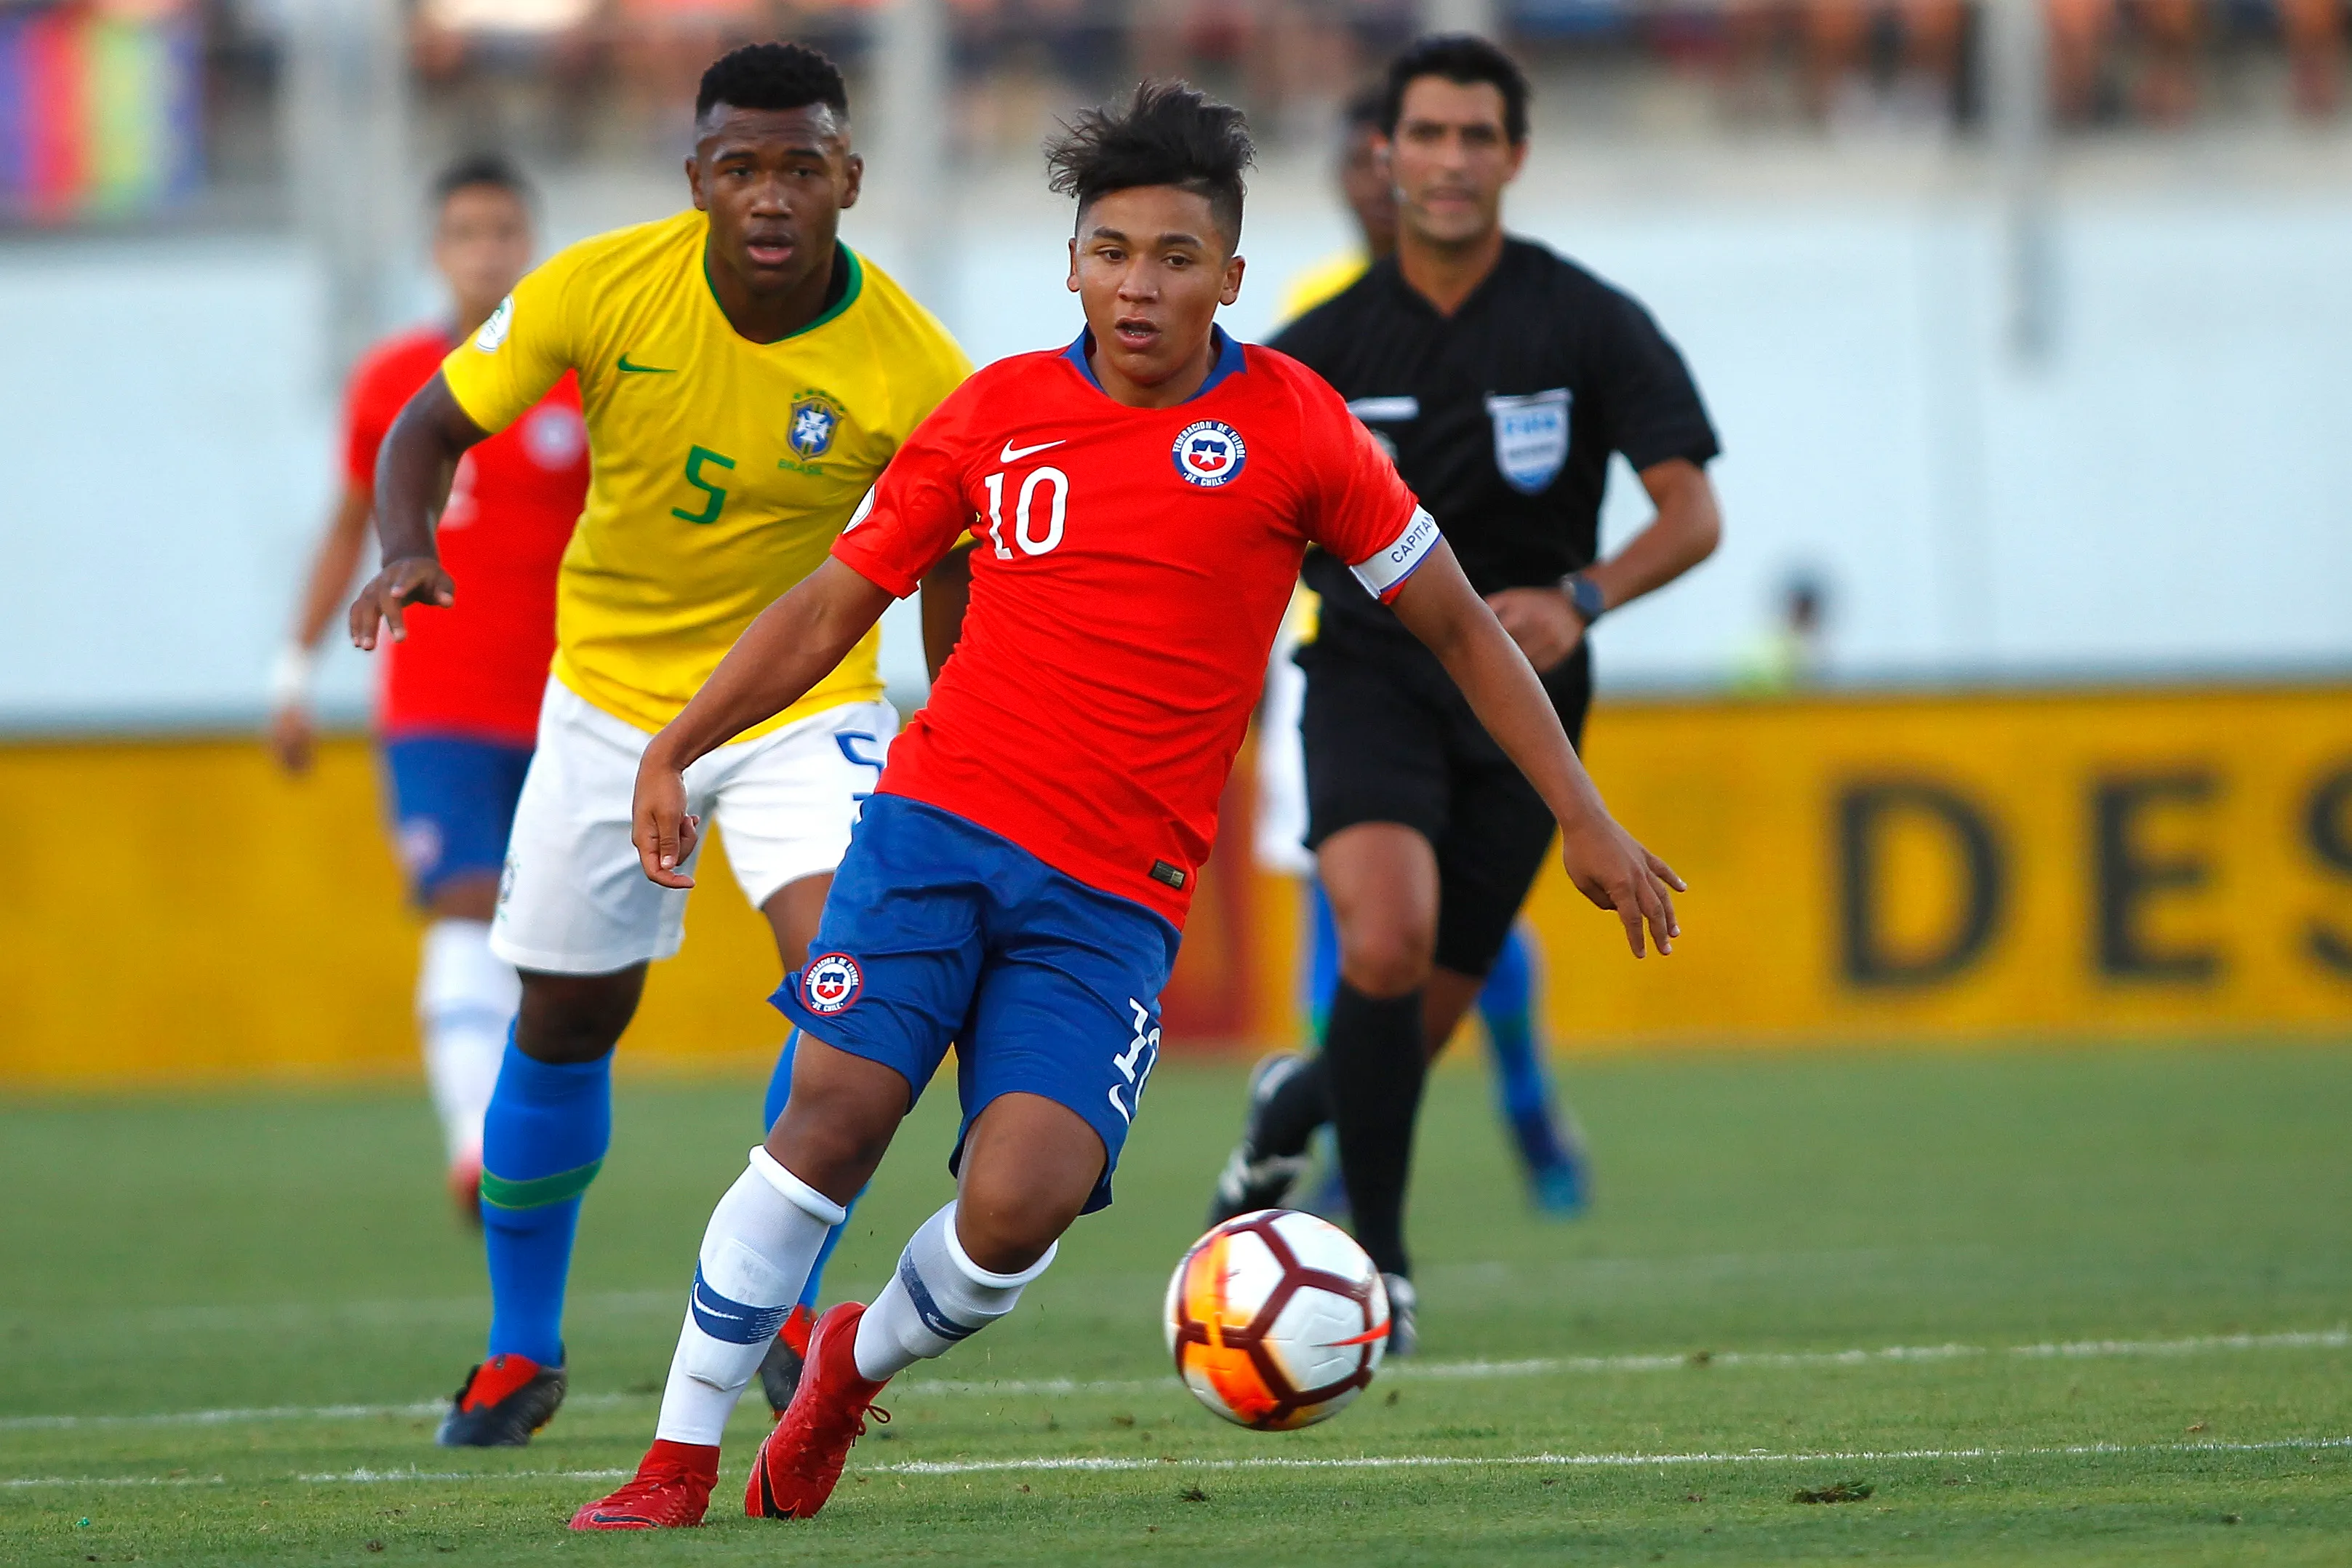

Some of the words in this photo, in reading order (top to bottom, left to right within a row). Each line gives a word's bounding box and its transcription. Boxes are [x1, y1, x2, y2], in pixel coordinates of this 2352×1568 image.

[1172, 420, 1212, 452] FEDERACION
[1216, 423, 1230, 433] DE
[1228, 431, 1246, 459] FUTBOL
[671, 444, 737, 524] 5
[1184, 473, 1197, 484] DE
[1200, 476, 1225, 487] CHILE
[985, 465, 1070, 560] 10
